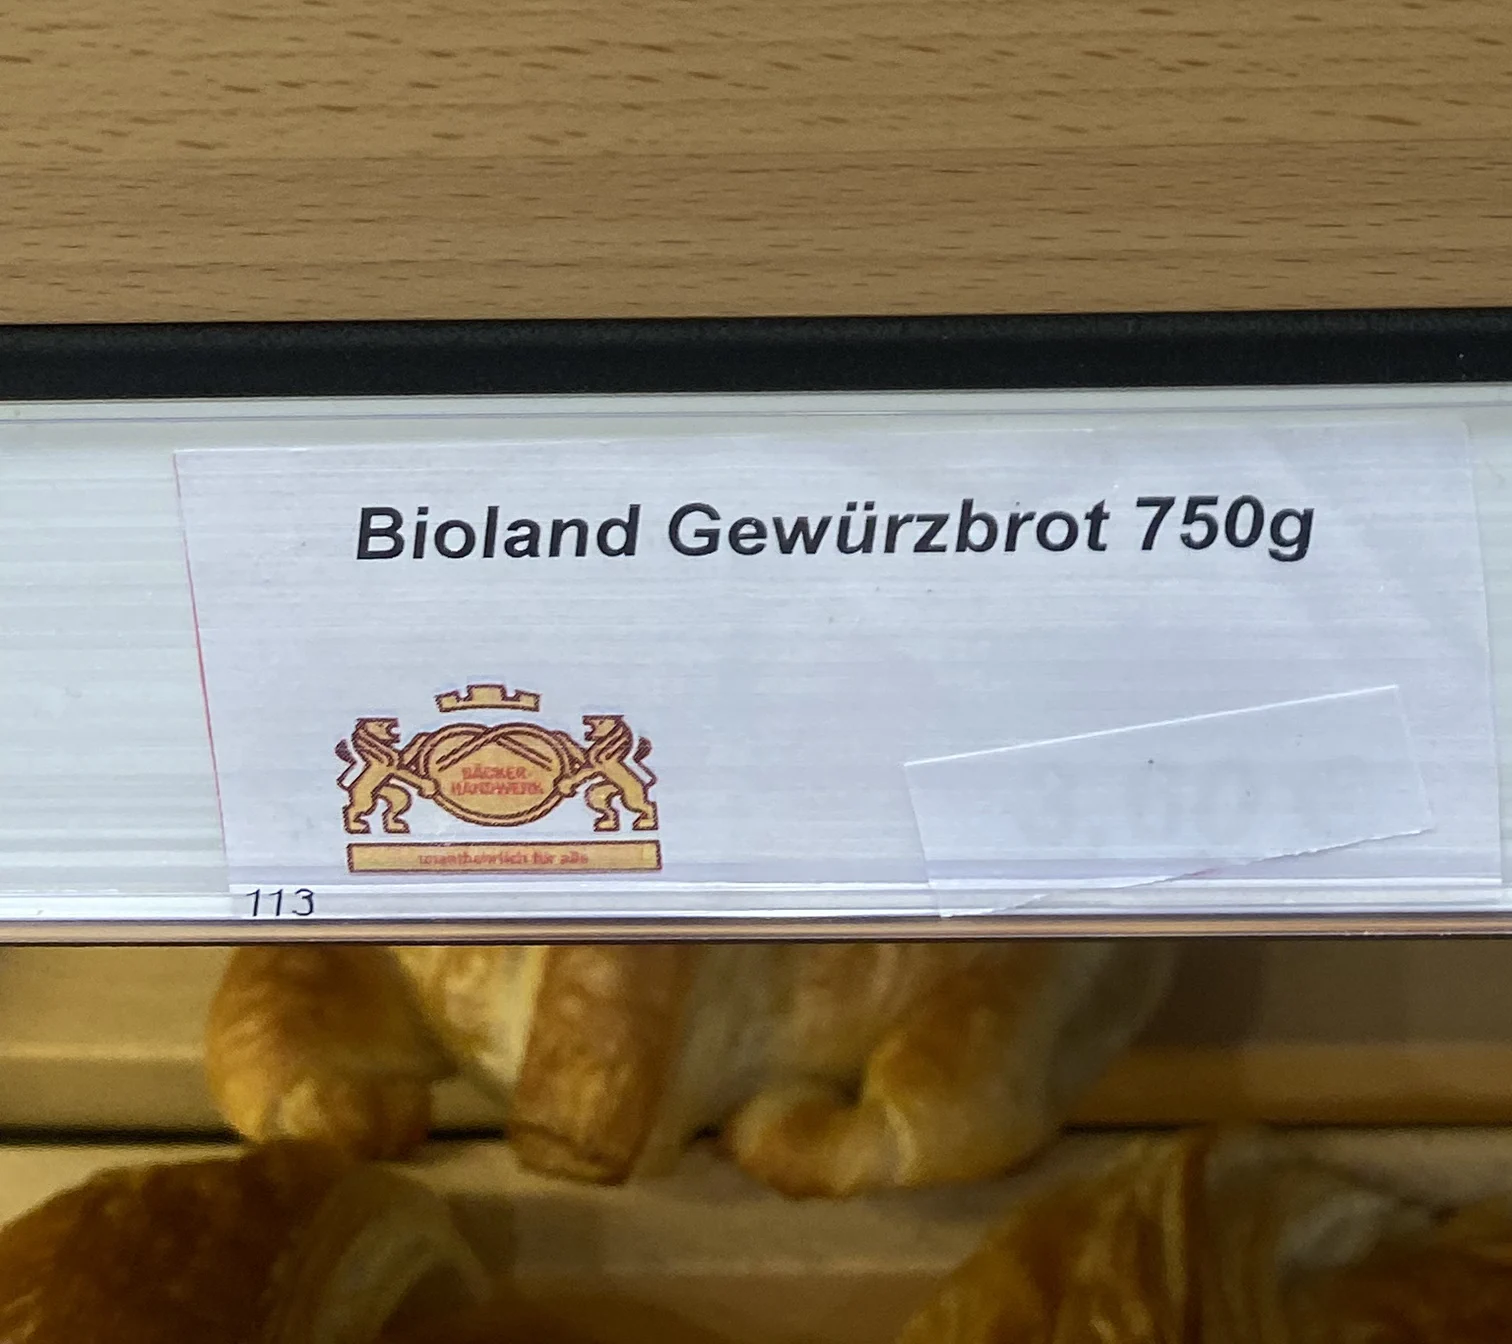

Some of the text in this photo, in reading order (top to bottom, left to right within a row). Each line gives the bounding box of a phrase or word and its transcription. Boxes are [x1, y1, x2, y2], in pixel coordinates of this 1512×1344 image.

[355, 494, 1315, 564] Bioland Gewürzbrot 750g
[246, 888, 314, 917] 113
